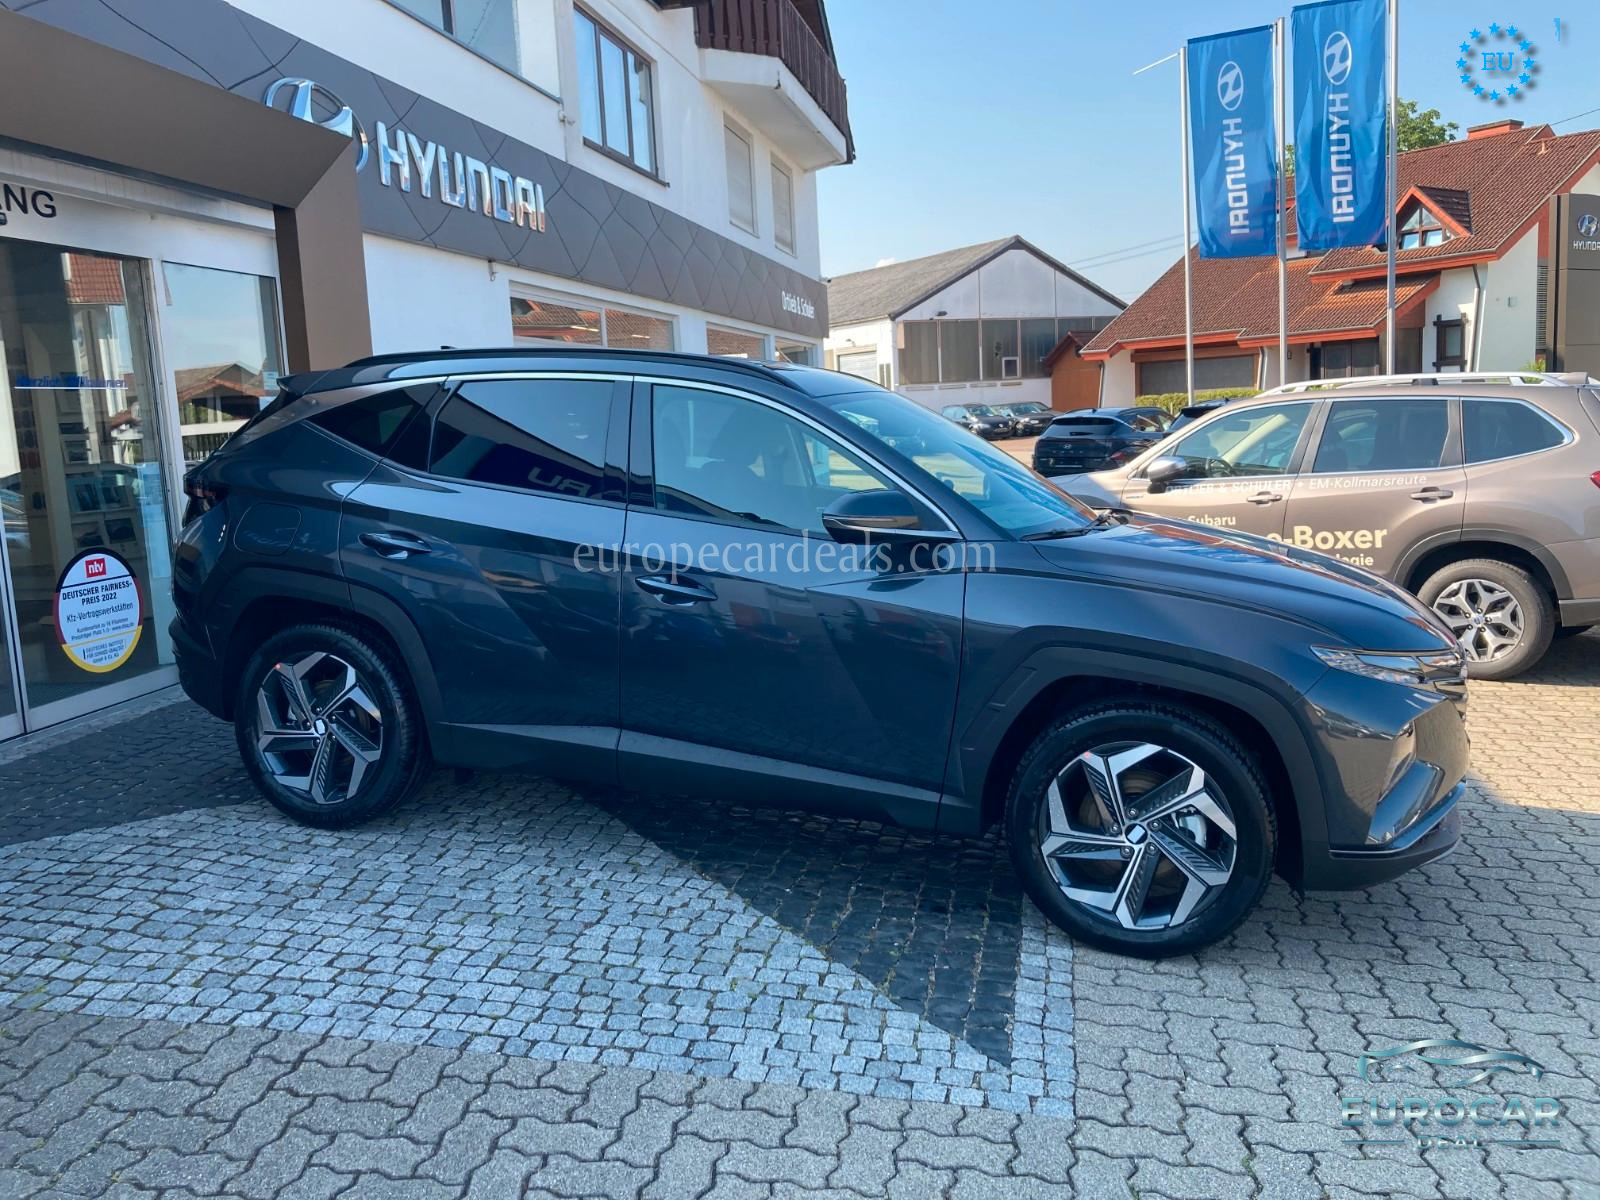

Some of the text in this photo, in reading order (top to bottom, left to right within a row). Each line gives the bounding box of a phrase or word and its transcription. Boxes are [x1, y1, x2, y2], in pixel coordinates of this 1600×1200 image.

[376, 120, 546, 233] HYUNDAI
[1222, 117, 1250, 235] HYUNDAI
[1328, 92, 1355, 223] HYUNDAI
[0, 183, 57, 218] NG
[62, 586, 100, 601] DEUTSCHER
[81, 592, 117, 606] PREIS 2022
